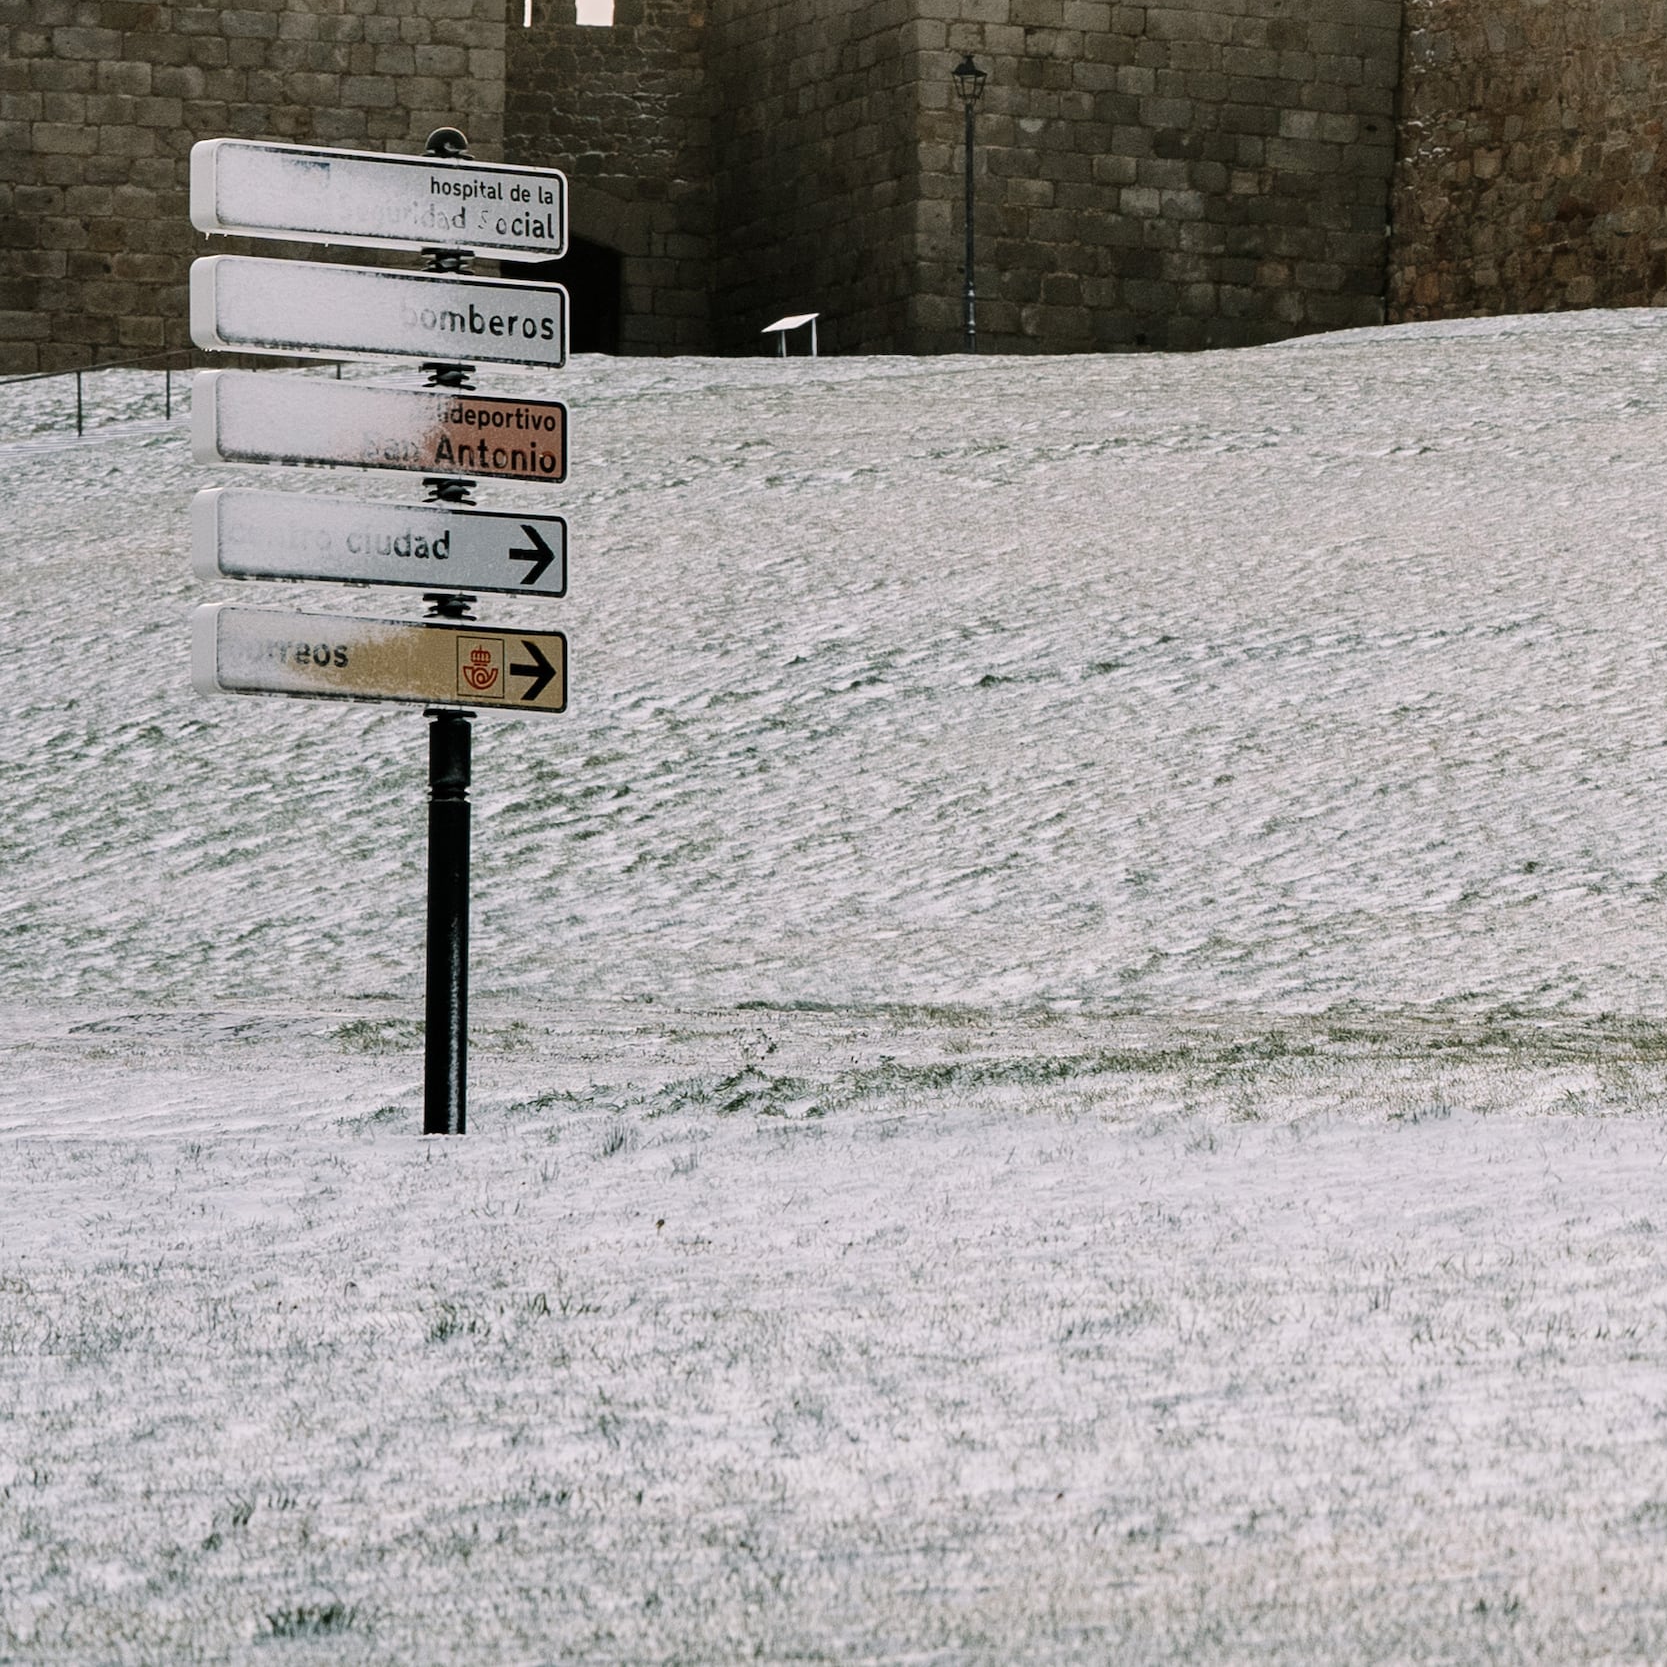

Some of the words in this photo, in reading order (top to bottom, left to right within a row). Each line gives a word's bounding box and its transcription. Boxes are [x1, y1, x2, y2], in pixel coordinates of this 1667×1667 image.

[430, 176, 503, 201] hospital
[510, 184, 531, 203] de
[538, 186, 554, 205] la
[401, 301, 555, 340] bomberos
[434, 434, 556, 474] Antonio
[345, 527, 450, 560] ciudad
